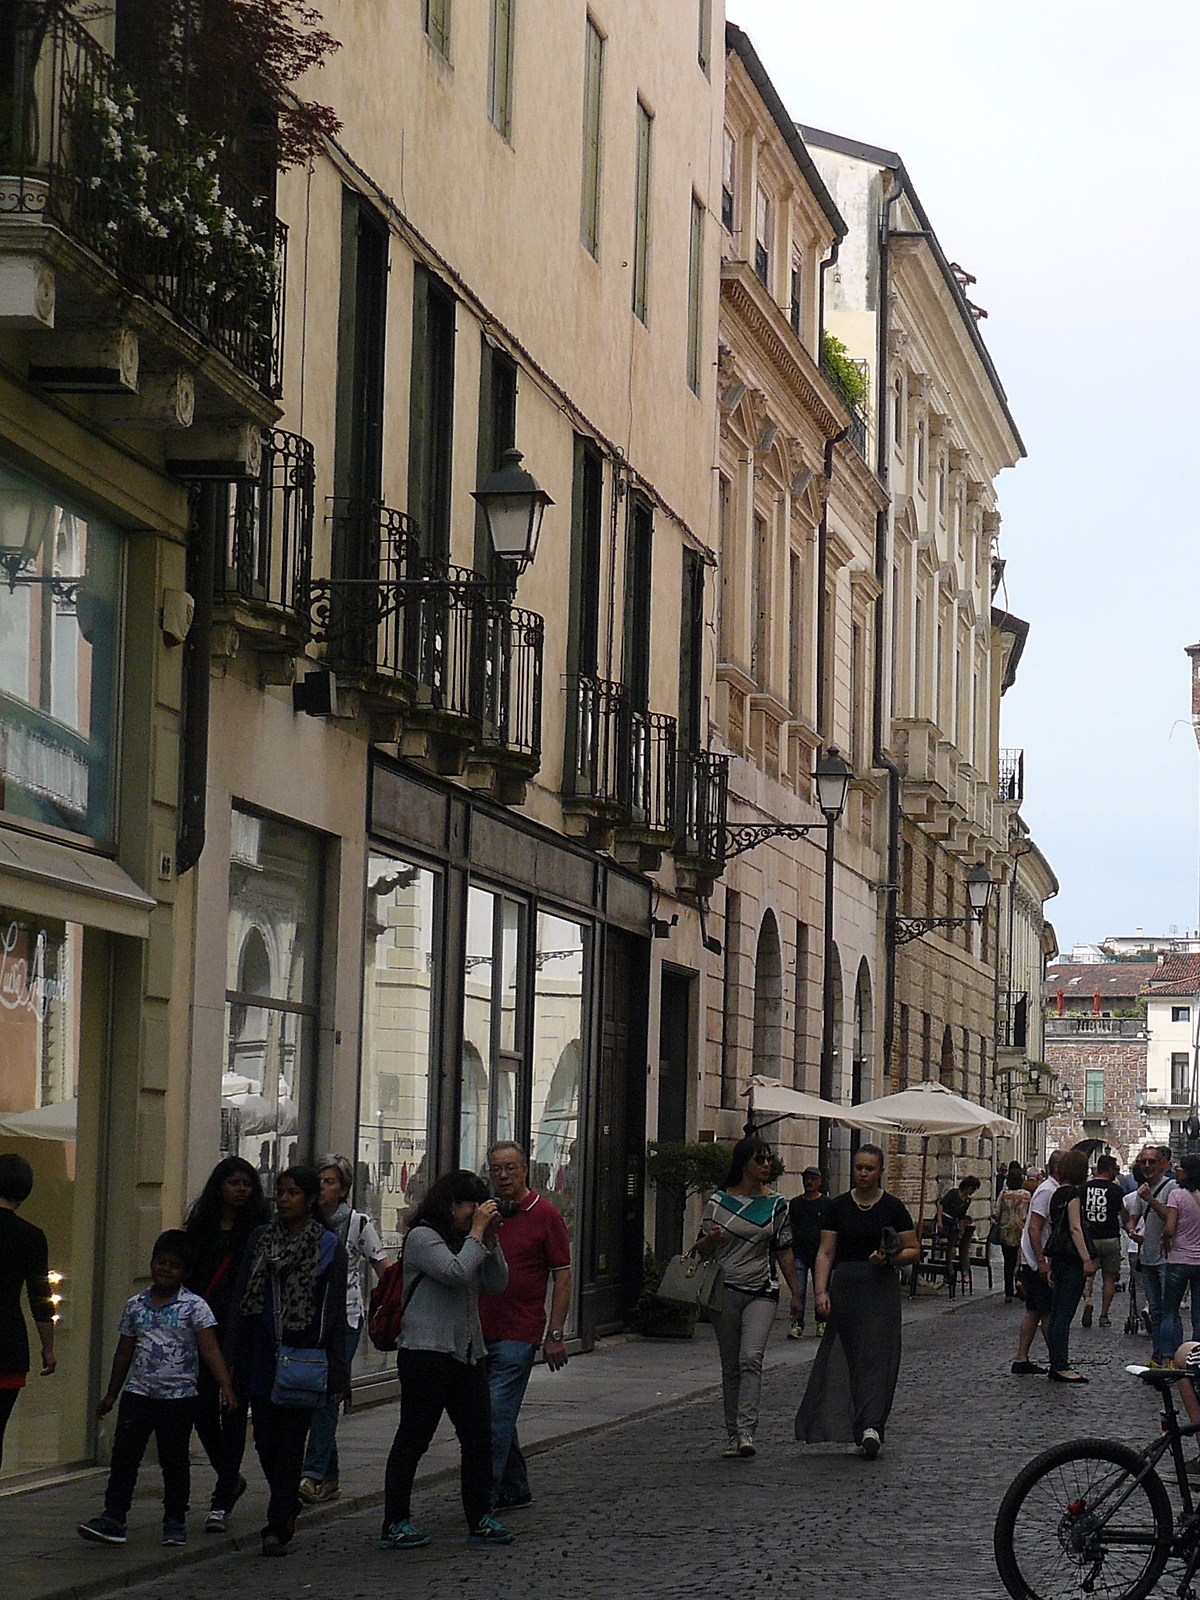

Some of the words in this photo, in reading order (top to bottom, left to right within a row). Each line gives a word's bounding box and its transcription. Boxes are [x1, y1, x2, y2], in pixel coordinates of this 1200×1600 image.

[1086, 1187, 1108, 1196] HEY
[1086, 1195, 1107, 1206] HO
[1086, 1211, 1107, 1222] GO
